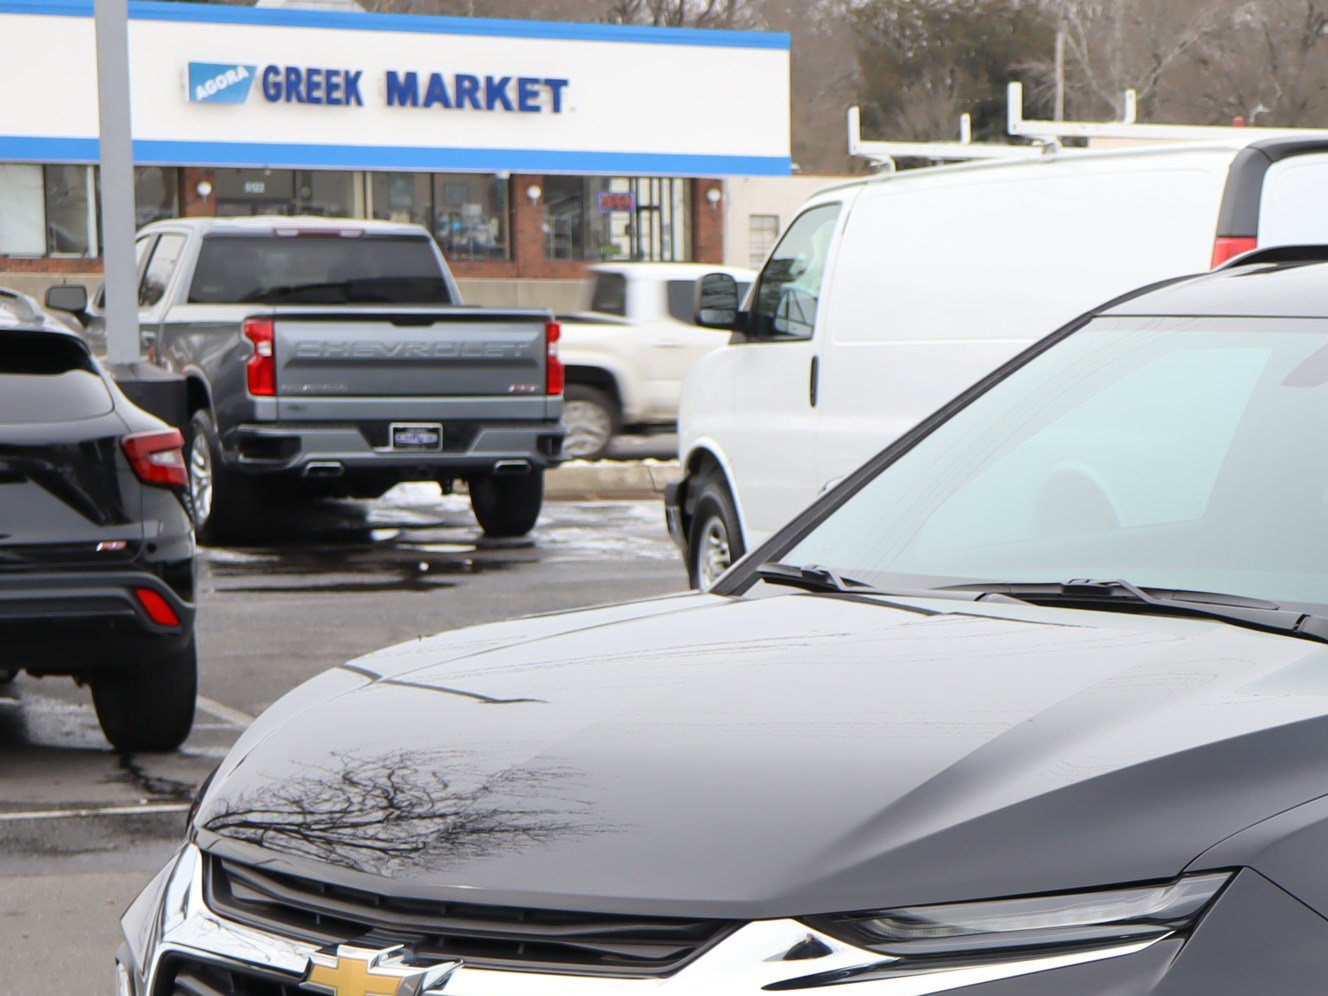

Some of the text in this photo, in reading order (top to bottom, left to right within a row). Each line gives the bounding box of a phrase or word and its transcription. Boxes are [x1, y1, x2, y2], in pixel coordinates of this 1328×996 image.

[195, 65, 250, 101] AGORA
[262, 64, 570, 114] GREEK MARKET
[296, 340, 529, 358] CHEVROLET
